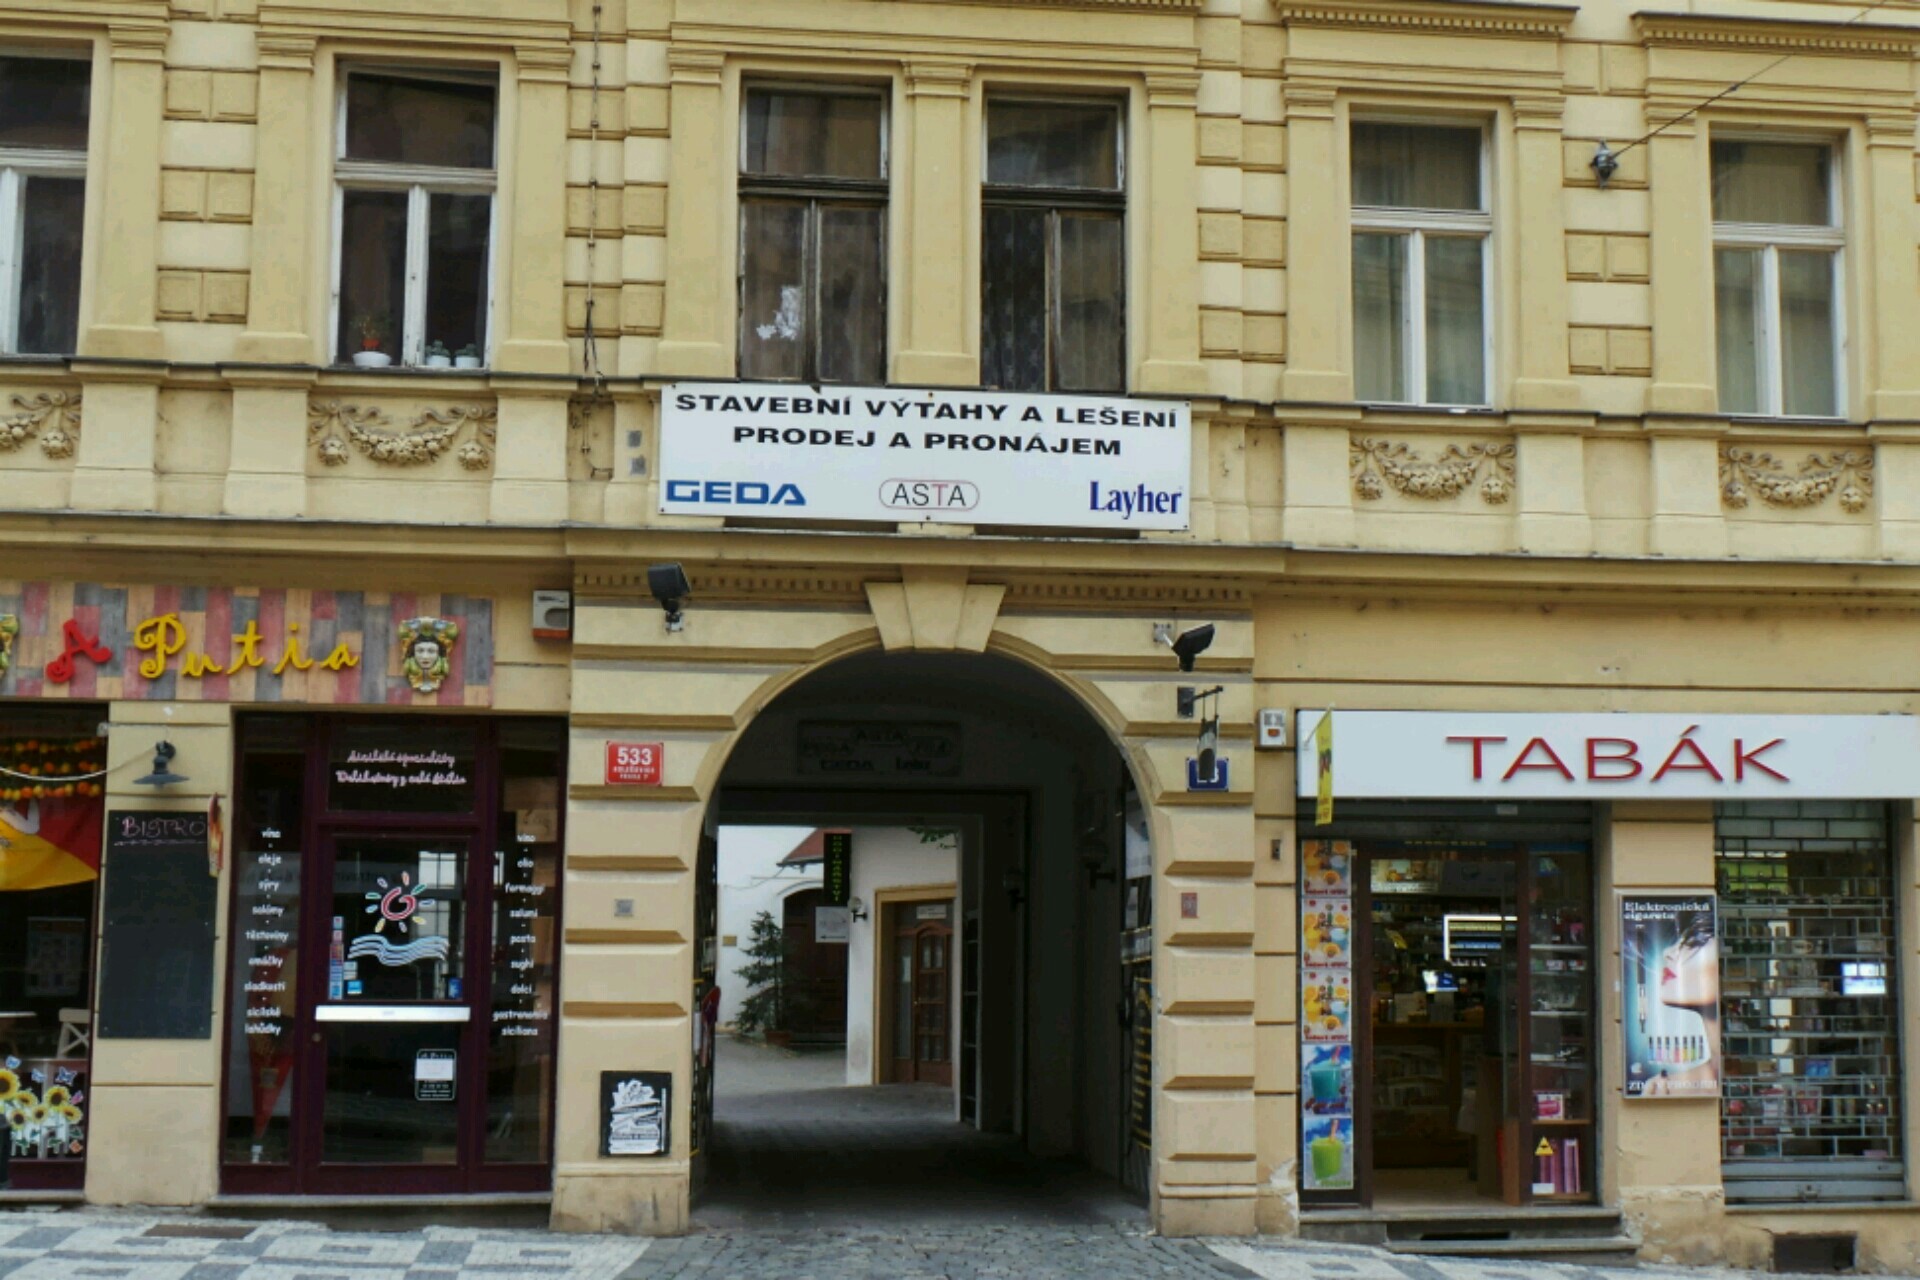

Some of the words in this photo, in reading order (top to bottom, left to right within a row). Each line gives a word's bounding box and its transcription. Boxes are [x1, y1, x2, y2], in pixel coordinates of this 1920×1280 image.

[675, 394, 852, 417] STAVEBNÍ
[865, 398, 1008, 420] VÝTAHY
[1020, 405, 1043, 424] A
[1056, 405, 1177, 428] LEŠENÍ
[733, 426, 875, 449] PRODEJ
[888, 431, 912, 450] A
[924, 431, 1122, 456] PRONÁJEM
[665, 479, 807, 506] GEDA
[890, 482, 967, 508] ASTA
[1088, 480, 1183, 520] Layher
[46, 618, 113, 684] A
[132, 612, 361, 680] Putia
[616, 746, 653, 766] 533
[1444, 724, 1791, 784] TABÁK
[121, 815, 206, 838] BISTRO
[1624, 911, 1677, 921] cigareta
[510, 935, 536, 945] pasta
[510, 983, 532, 994] dolci
